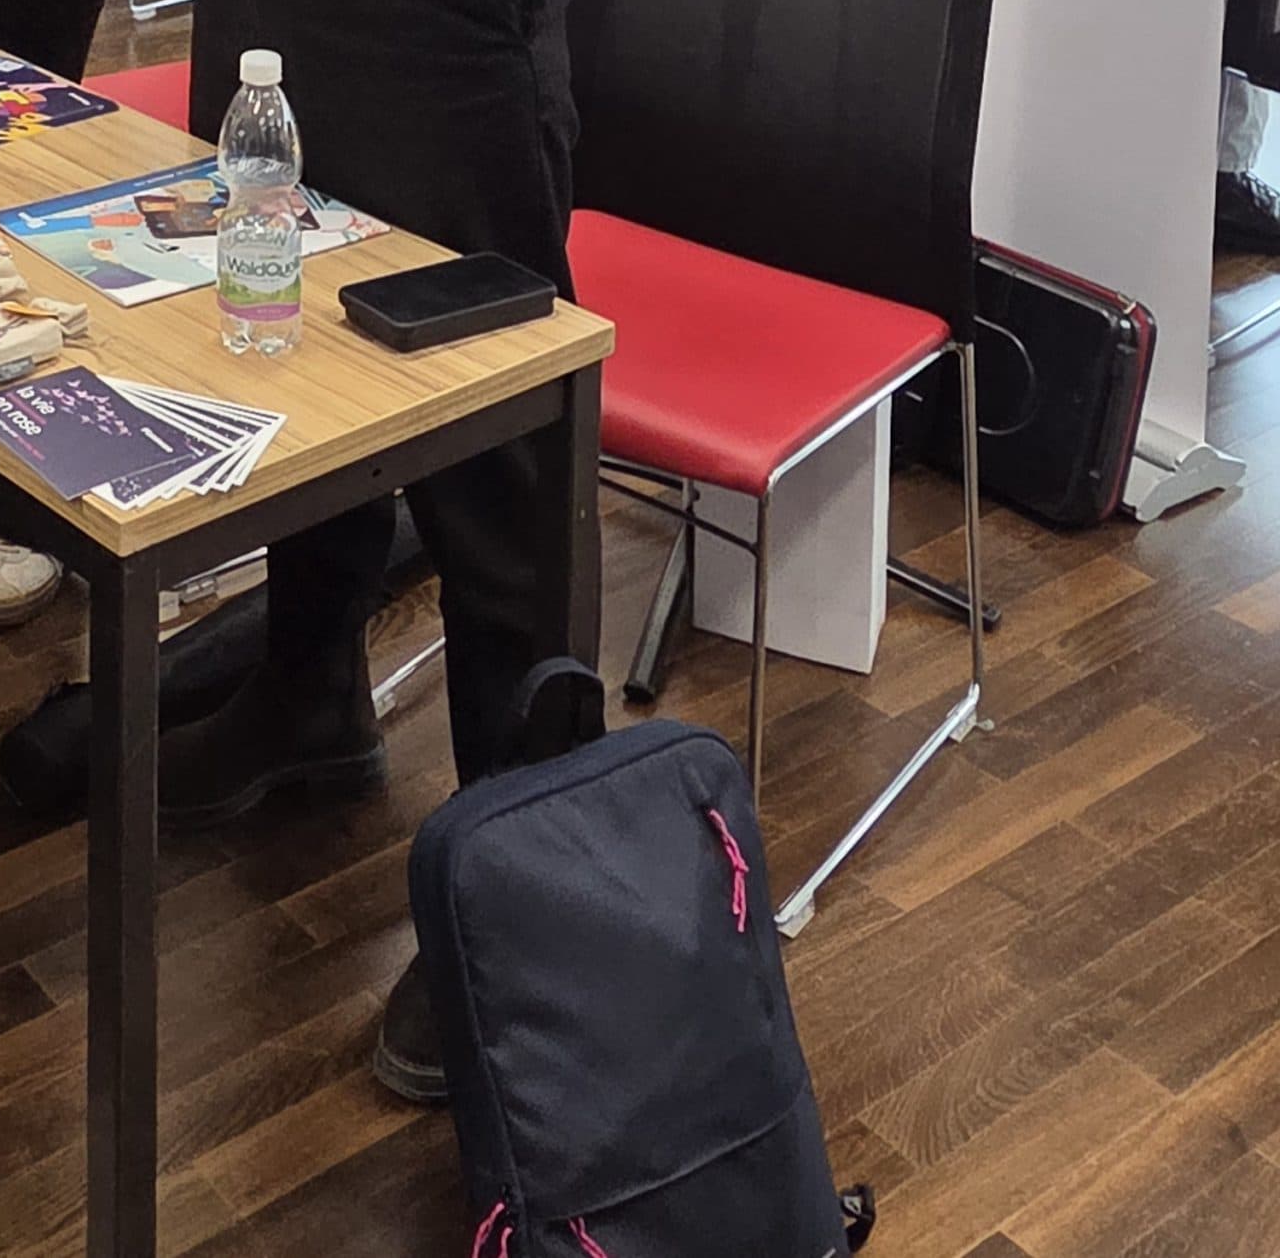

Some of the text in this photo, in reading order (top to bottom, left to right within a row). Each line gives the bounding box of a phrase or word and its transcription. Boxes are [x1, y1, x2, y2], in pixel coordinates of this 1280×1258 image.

[16, 385, 56, 415] la vie
[7, 409, 42, 435] rose
